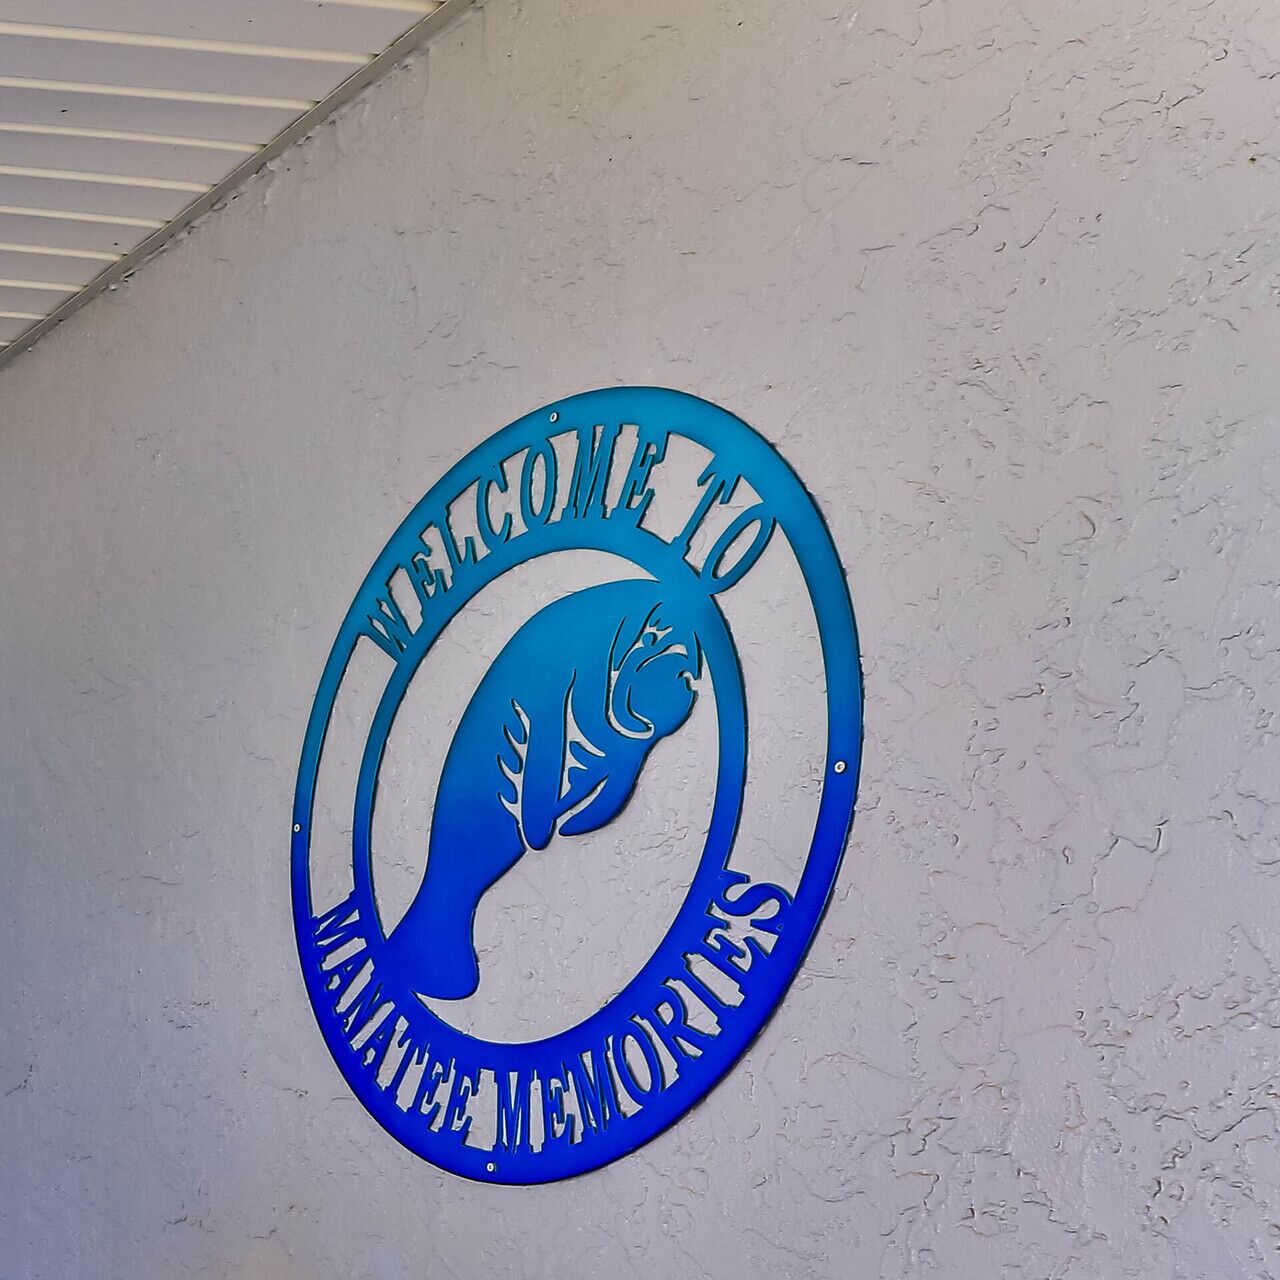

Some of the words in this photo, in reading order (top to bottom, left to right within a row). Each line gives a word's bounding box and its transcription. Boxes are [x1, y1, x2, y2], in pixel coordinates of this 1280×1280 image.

[367, 424, 668, 656] WELCOME
[682, 466, 777, 595] TO
[312, 890, 484, 1142] MANATEE
[495, 873, 795, 1154] MEMORIES
